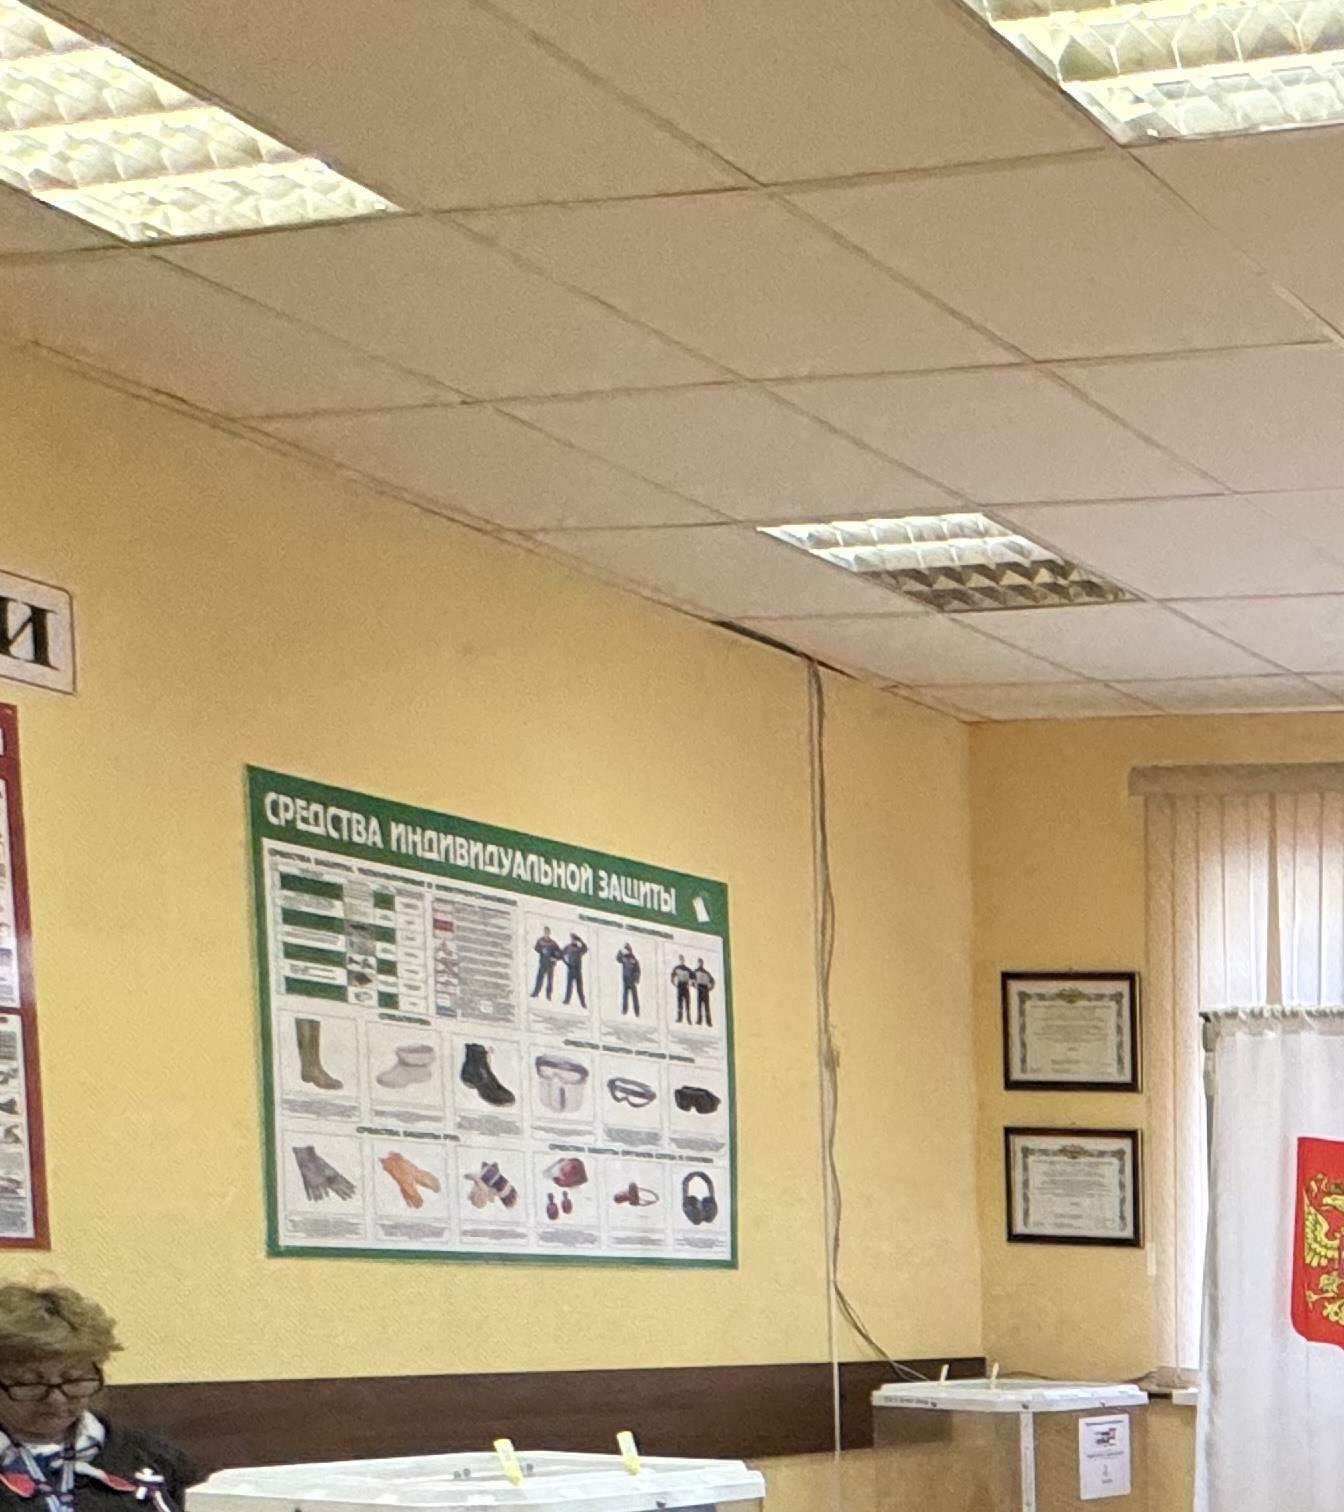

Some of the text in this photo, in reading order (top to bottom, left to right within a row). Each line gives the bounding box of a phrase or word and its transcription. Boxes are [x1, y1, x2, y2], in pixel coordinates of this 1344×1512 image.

[264, 791, 384, 849] СРЕДСТВА
[390, 820, 594, 896] ИНДИВИДУАЛЬНОЙ
[597, 869, 678, 916] ЗАЩИТЫ
